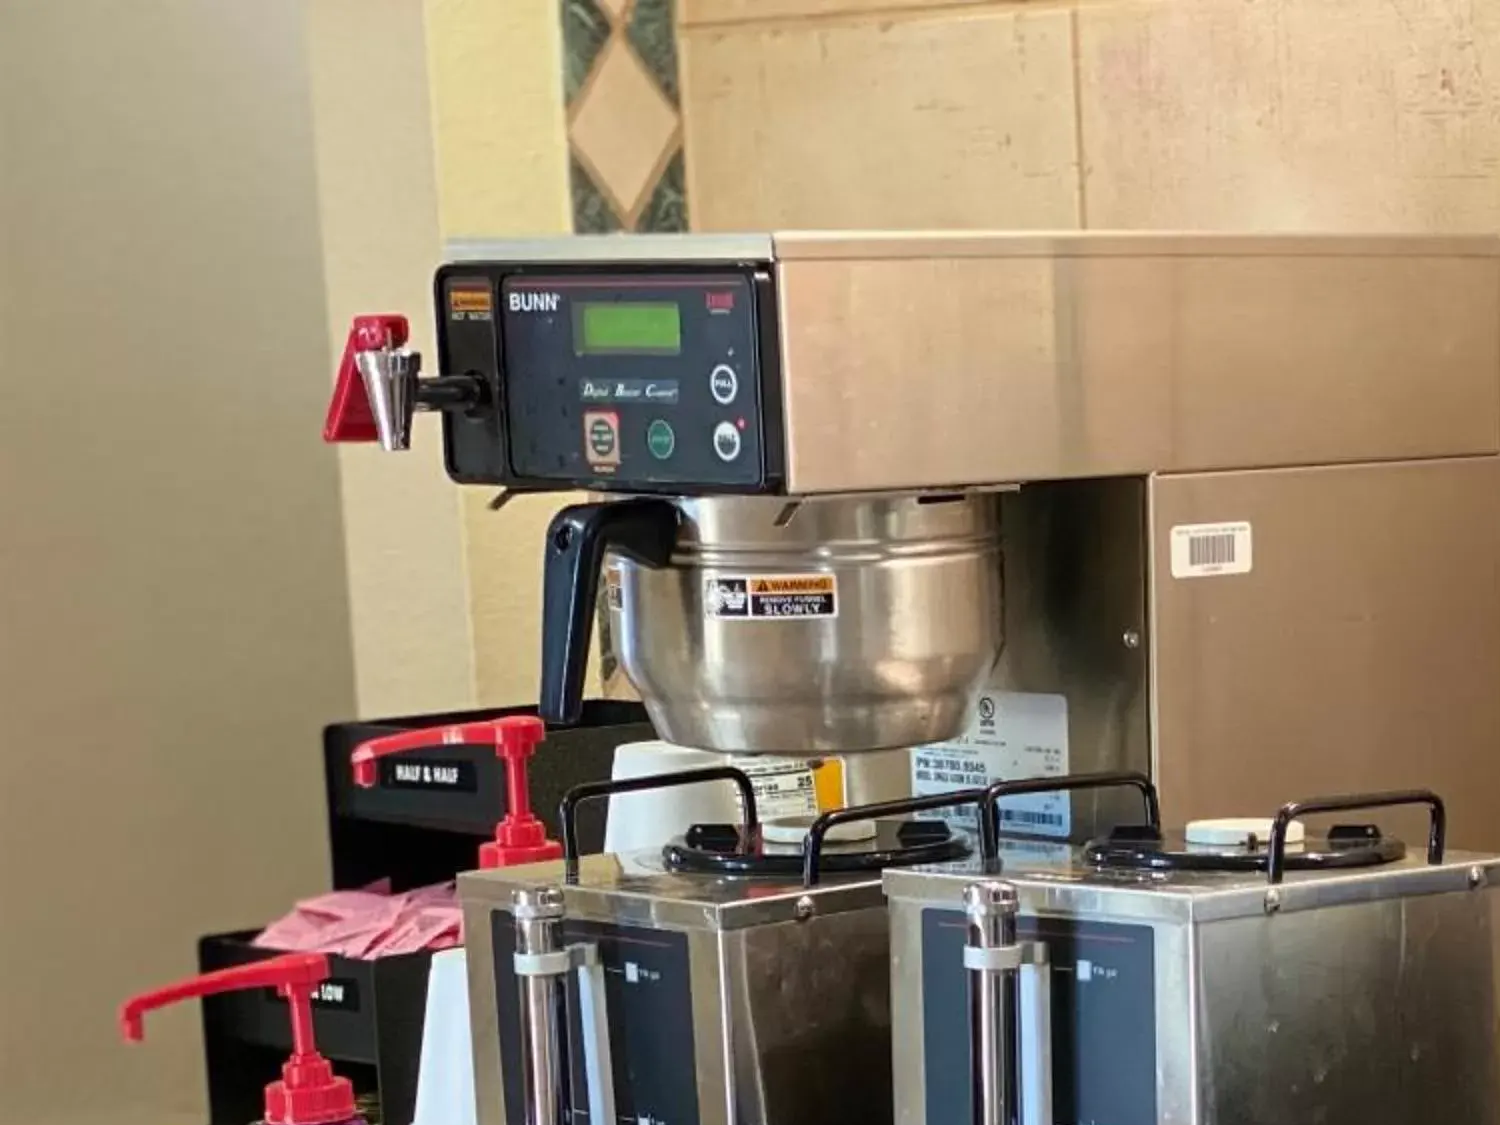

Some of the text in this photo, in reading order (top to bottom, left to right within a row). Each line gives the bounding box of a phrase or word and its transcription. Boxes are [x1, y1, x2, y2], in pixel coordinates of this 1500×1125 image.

[509, 291, 558, 312] BUNN
[763, 603, 821, 616] SLOWLY
[396, 764, 458, 784] HALF & HALF
[321, 984, 344, 1002] LOW
